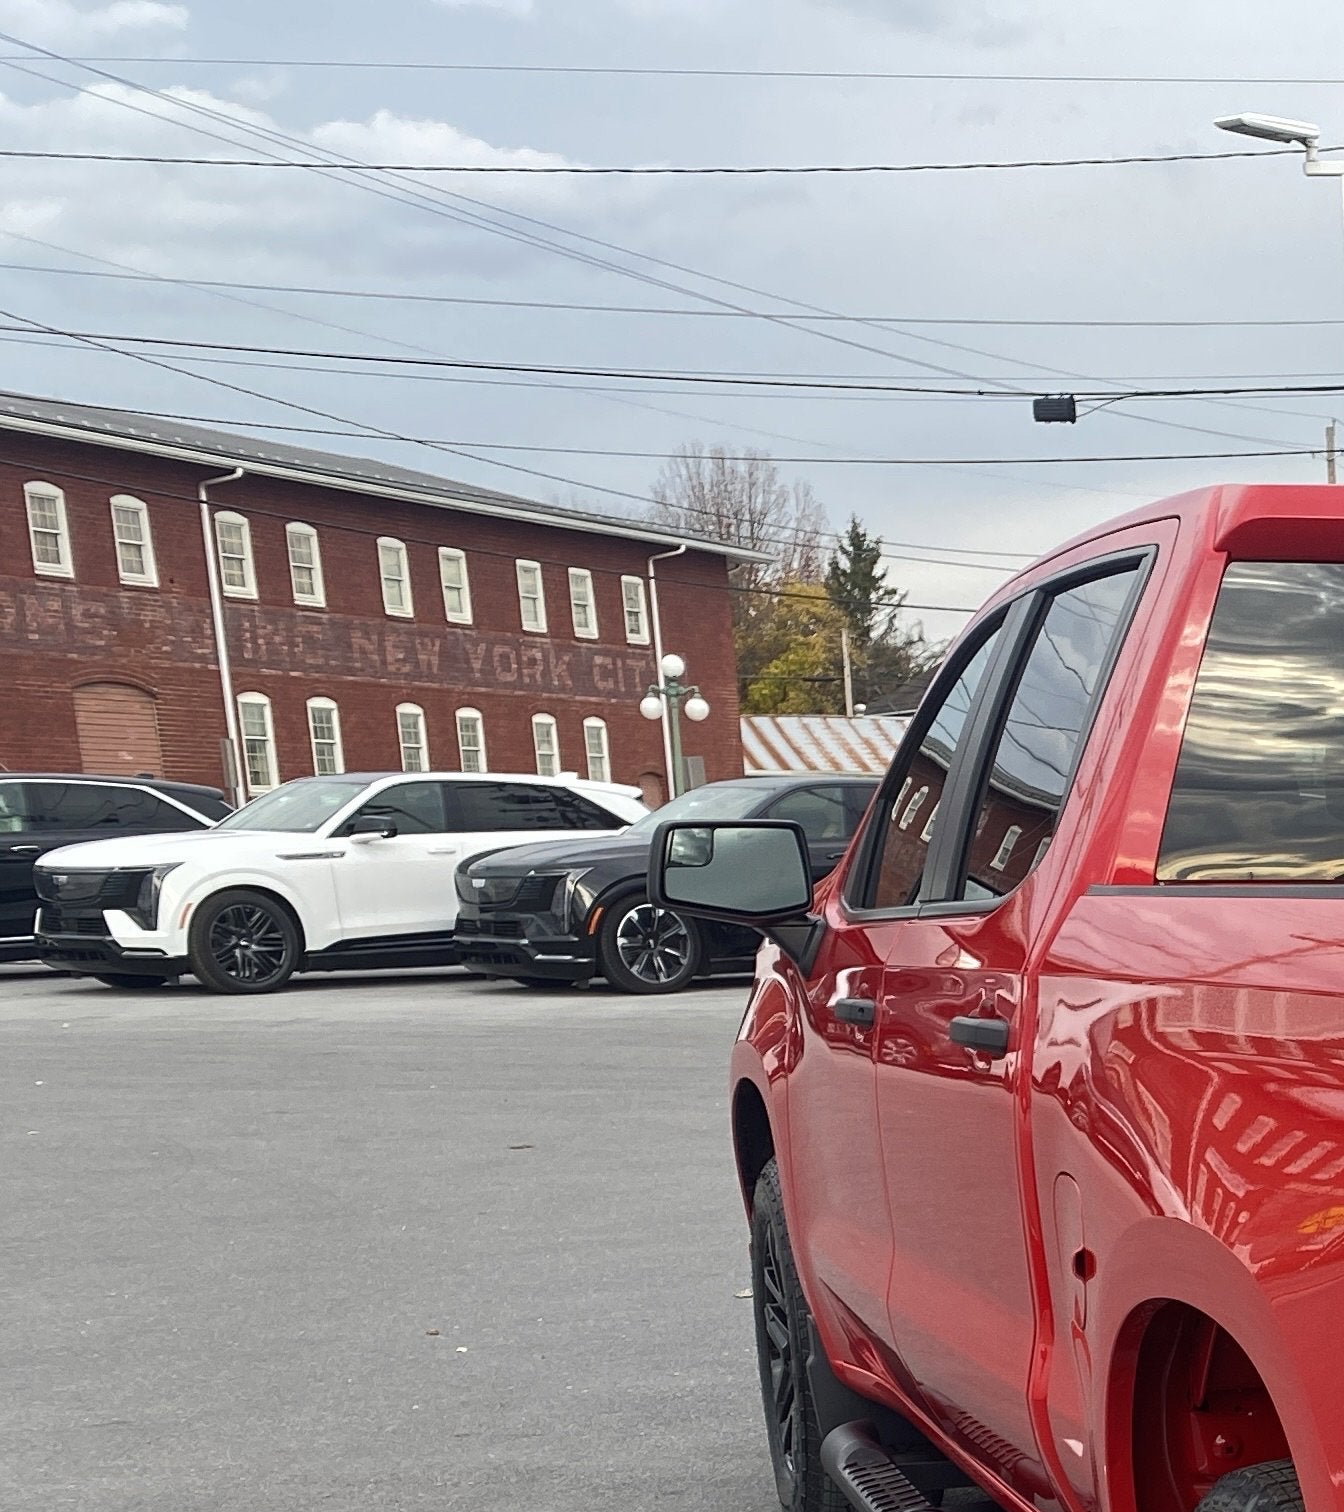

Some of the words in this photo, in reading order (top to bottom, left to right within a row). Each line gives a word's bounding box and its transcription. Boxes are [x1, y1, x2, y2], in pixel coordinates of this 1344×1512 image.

[351, 627, 441, 675] NEW
[464, 641, 573, 690] YORK
[593, 653, 661, 694] CIT
